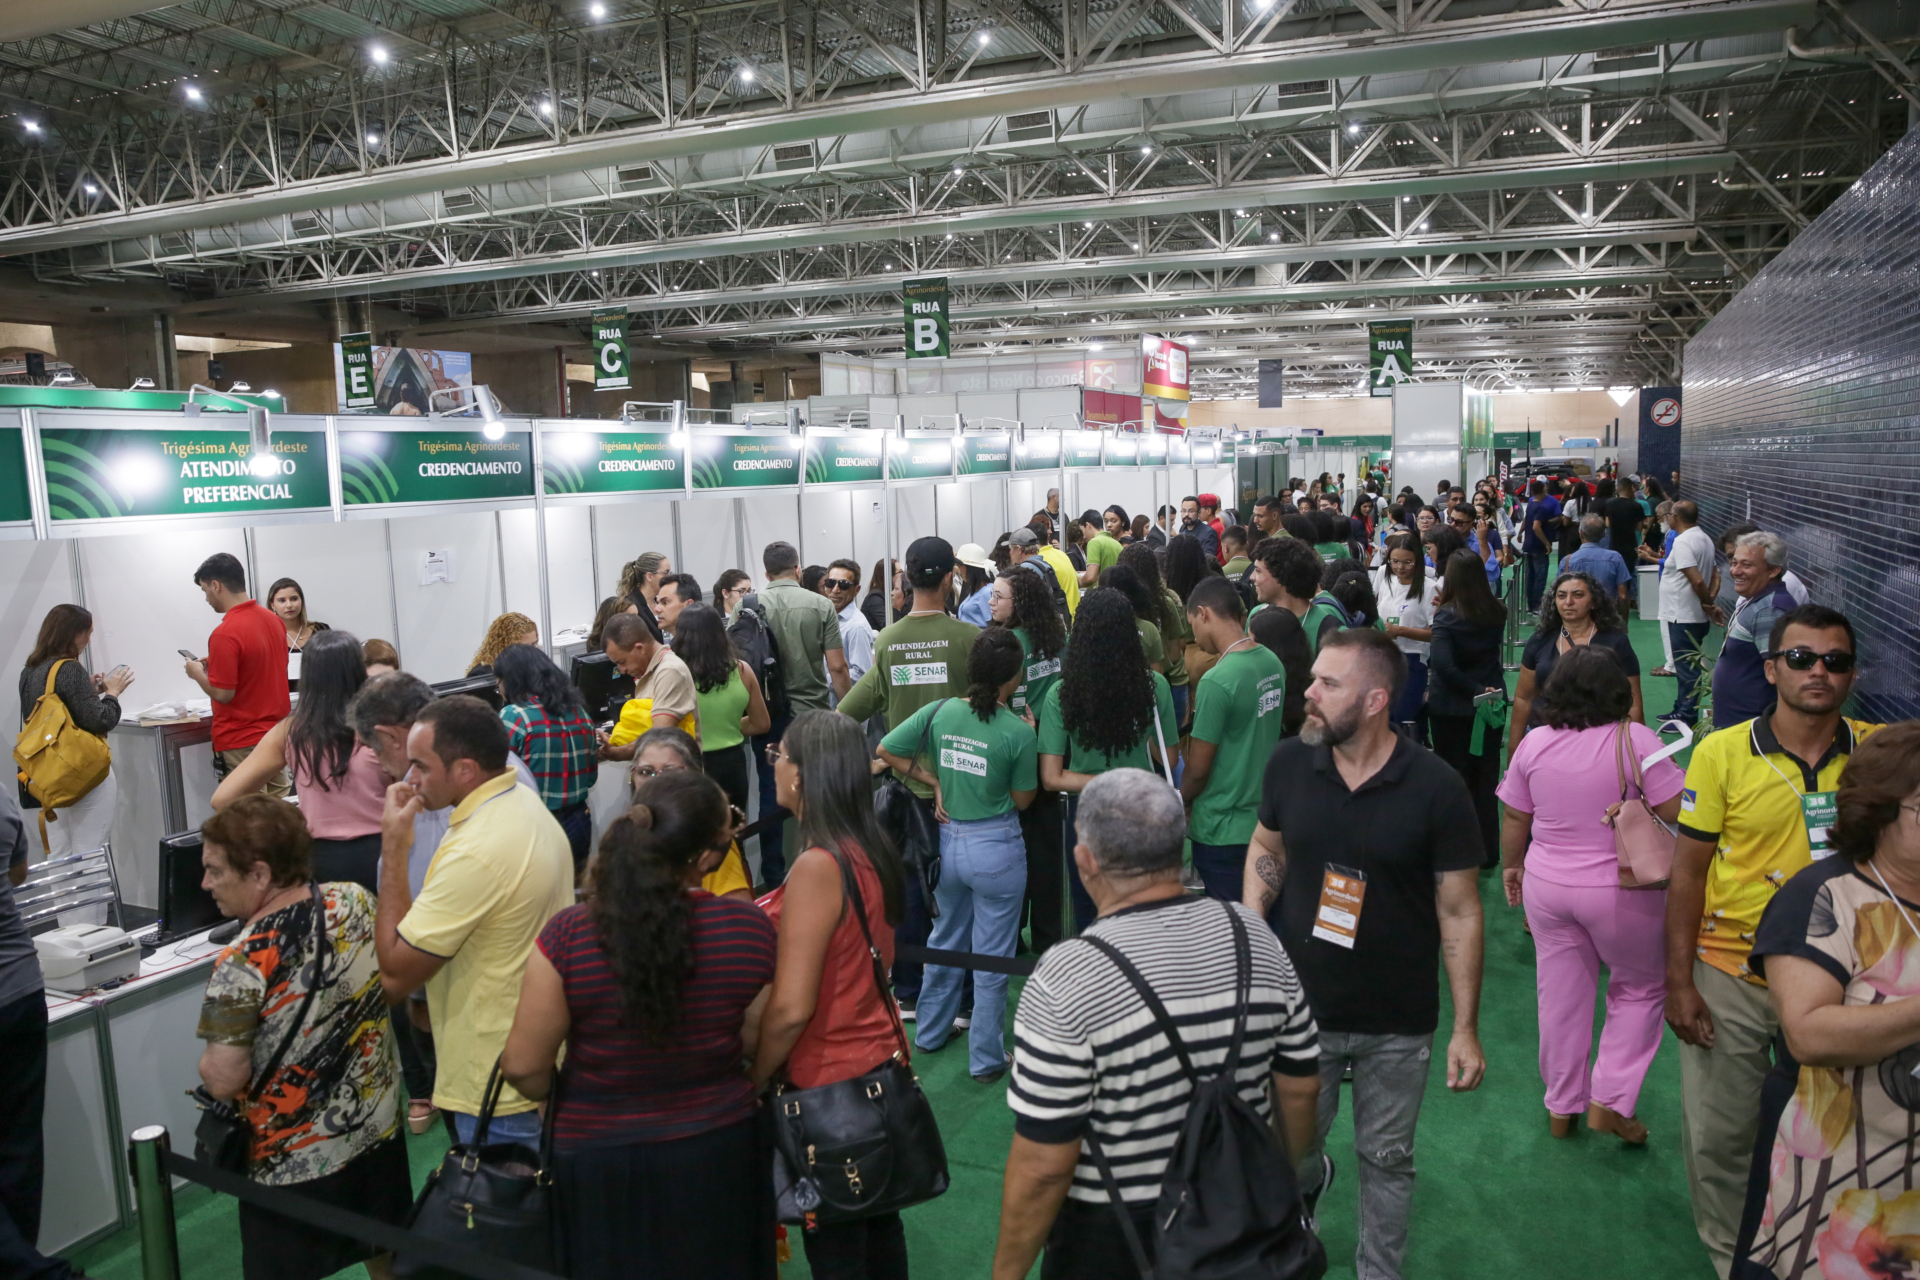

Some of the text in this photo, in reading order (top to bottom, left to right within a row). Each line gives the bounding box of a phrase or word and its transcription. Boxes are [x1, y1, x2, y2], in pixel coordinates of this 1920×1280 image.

[906, 285, 946, 296] Agrinordeste
[912, 301, 940, 314] RUA
[599, 328, 622, 340] RUA
[913, 318, 940, 352] B
[1378, 340, 1404, 350] RUA
[348, 353, 367, 364] RUA
[601, 342, 622, 372] C
[1377, 354, 1405, 383] A
[350, 366, 368, 394] E
[161, 442, 308, 458] Trigésima Agrrdeste
[418, 440, 520, 454] Trigésima Agrinordeste
[598, 441, 632, 453] Trigésima
[598, 459, 675, 472] CREDENCIAMENTO
[733, 458, 792, 470] CREDENCIAMENTO
[836, 457, 878, 466] CREDENCIAMENTO
[180, 460, 296, 478] ATENDIMTO
[418, 461, 522, 476] CREDENCIAMENTO
[183, 484, 292, 504] PREFERENCIAL
[888, 640, 949, 652] APRENDIZAGEM
[904, 651, 932, 660] RURAL
[914, 666, 947, 676] SENAR
[1040, 661, 1060, 672] SENAR
[940, 734, 988, 749] APRENDIZAGEM
[953, 742, 974, 752] RURAL
[956, 757, 986, 771] SENAR
[1324, 886, 1360, 904] Agrinordeste
